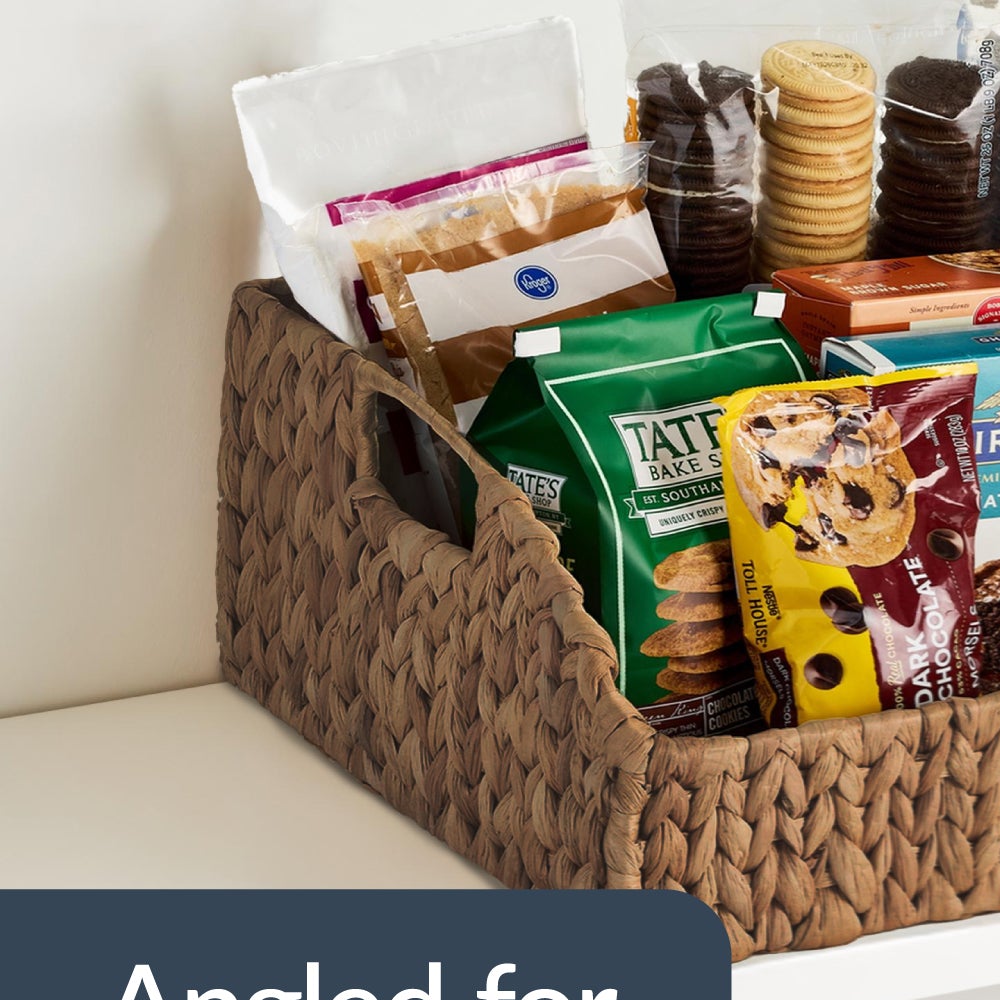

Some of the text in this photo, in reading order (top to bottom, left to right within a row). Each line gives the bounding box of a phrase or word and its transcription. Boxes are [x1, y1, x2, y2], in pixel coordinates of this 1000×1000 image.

[977, 177, 990, 198] NET
[521, 274, 551, 293] Kroger
[901, 282, 948, 291] SUGAR
[909, 302, 970, 314] Simple Ingredients
[648, 453, 723, 481] BAKE S
[509, 469, 559, 499] TATE'S
[643, 495, 660, 504] EST.
[659, 505, 725, 526] UNIQUELY CRISPY
[742, 560, 758, 595] TOLL
[873, 592, 897, 659] CHOCOLATE
[902, 556, 953, 708] DARK CHOCOLATE
[773, 657, 790, 685] DARK
[708, 686, 756, 716] CHOCOLAT
[708, 705, 751, 731] COOKIES
